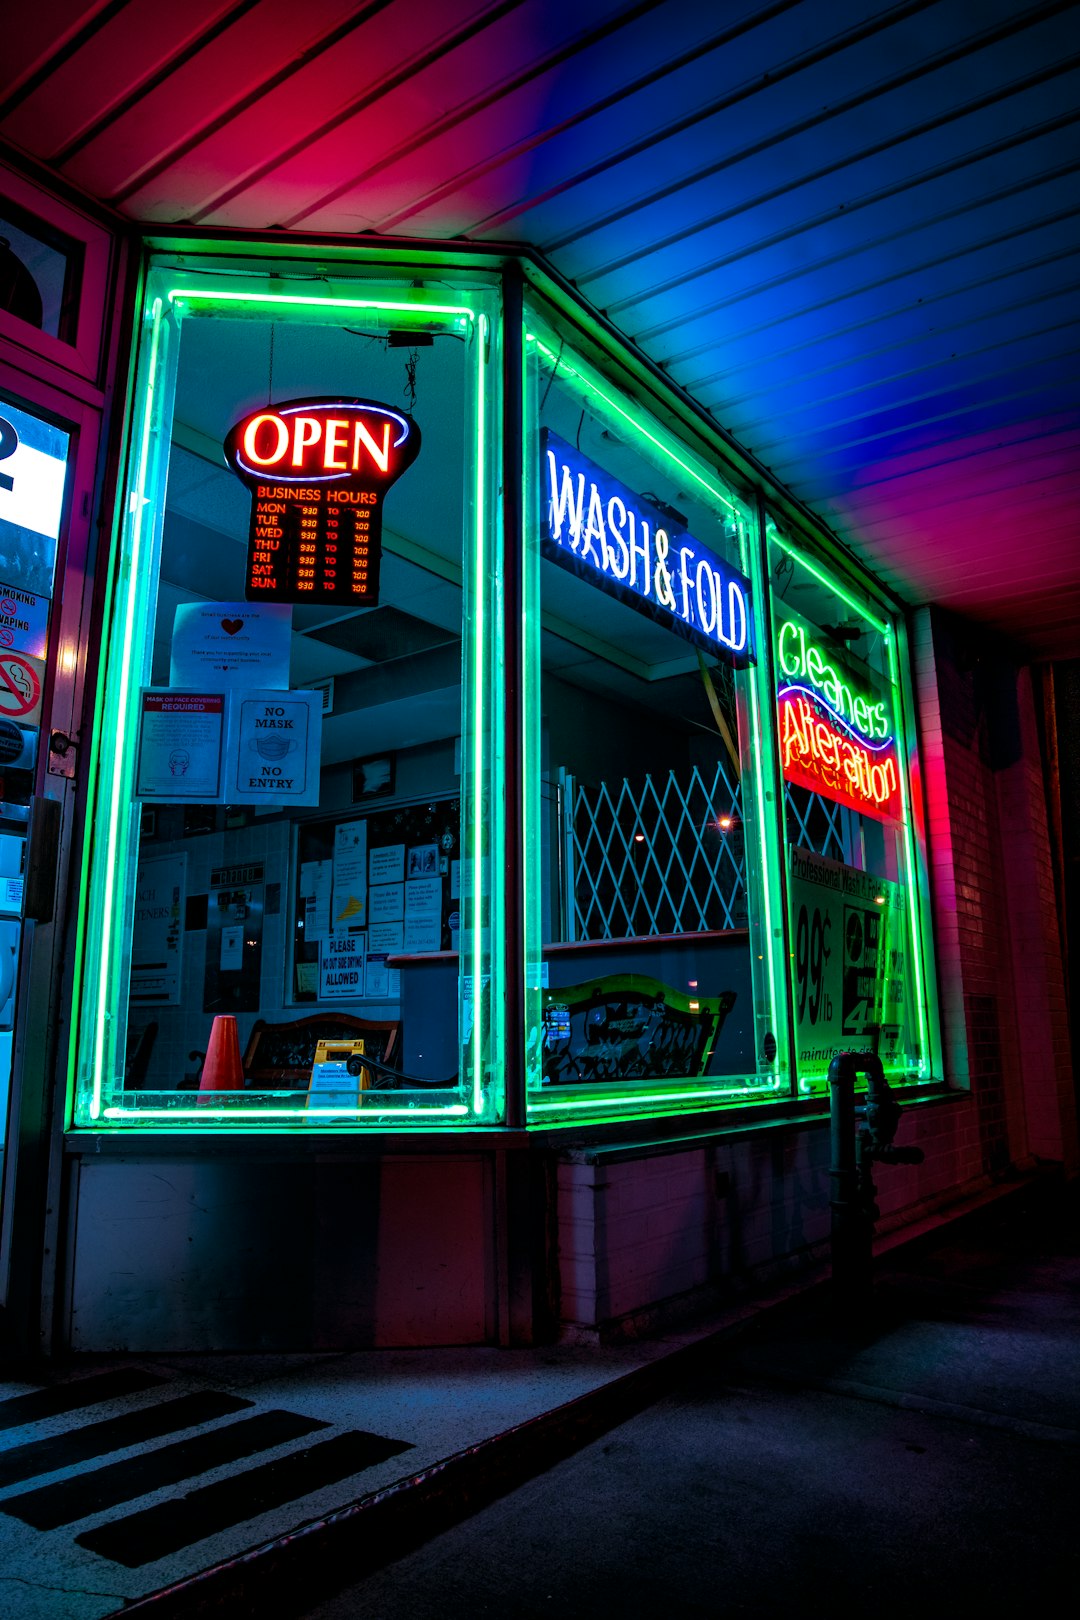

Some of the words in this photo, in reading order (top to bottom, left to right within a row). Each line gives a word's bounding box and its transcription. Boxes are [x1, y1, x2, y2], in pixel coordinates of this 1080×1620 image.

[244, 415, 390, 472] OPEN
[257, 486, 321, 501] BUSINESS
[327, 491, 377, 504] HOURS
[257, 503, 286, 513] MON
[257, 515, 278, 525] TUE
[255, 528, 282, 538] WED
[326, 532, 337, 540] TO
[255, 540, 279, 550] THU
[547, 450, 650, 596] WASH
[654, 529, 676, 611] &
[680, 547, 746, 651] FOLD
[253, 552, 271, 562] FRI
[252, 565, 273, 575] SAT
[252, 578, 276, 588] SUN
[323, 582, 335, 590] TO
[779, 621, 888, 739] Cleaners
[265, 707, 284, 716] NO
[255, 719, 293, 729] MASK
[783, 698, 897, 803] Alteration
[261, 767, 282, 775] NO
[249, 779, 293, 788] ENTRY
[792, 851, 840, 888] Professional
[842, 869, 859, 894] Wash
[330, 940, 355, 953] PLEASE
[326, 972, 358, 986] ALLOWED
